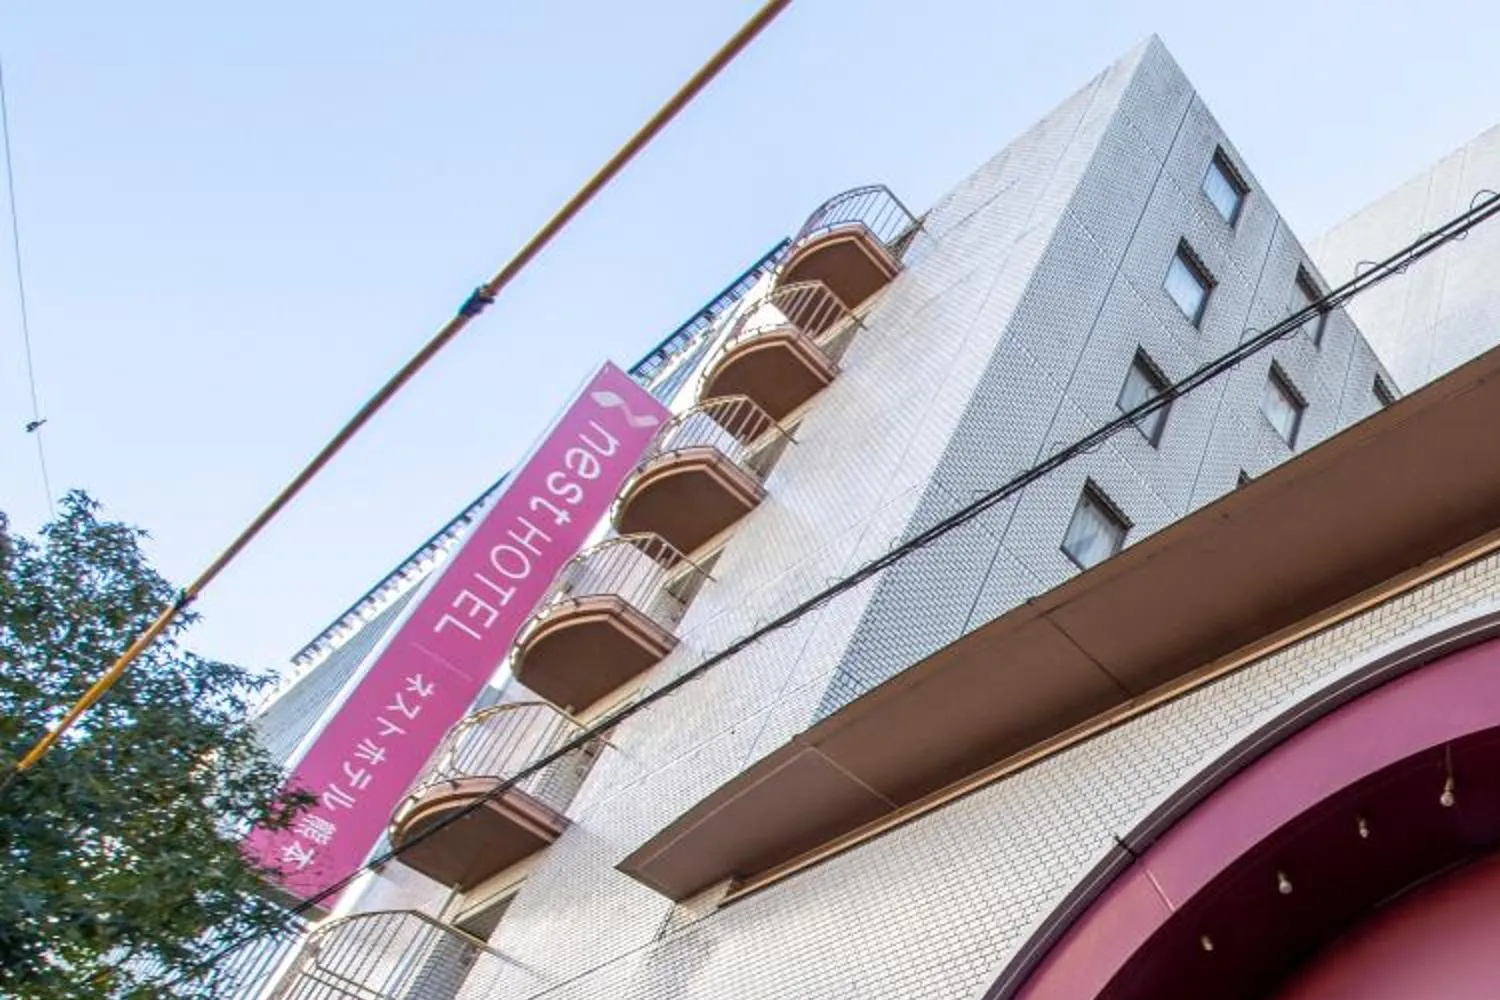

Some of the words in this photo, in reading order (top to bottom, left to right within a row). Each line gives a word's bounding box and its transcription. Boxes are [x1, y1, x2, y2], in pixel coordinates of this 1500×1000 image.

[529, 419, 621, 526] nest
[433, 516, 552, 641] HOTEL
[280, 673, 436, 869] ネストホテル熊本
